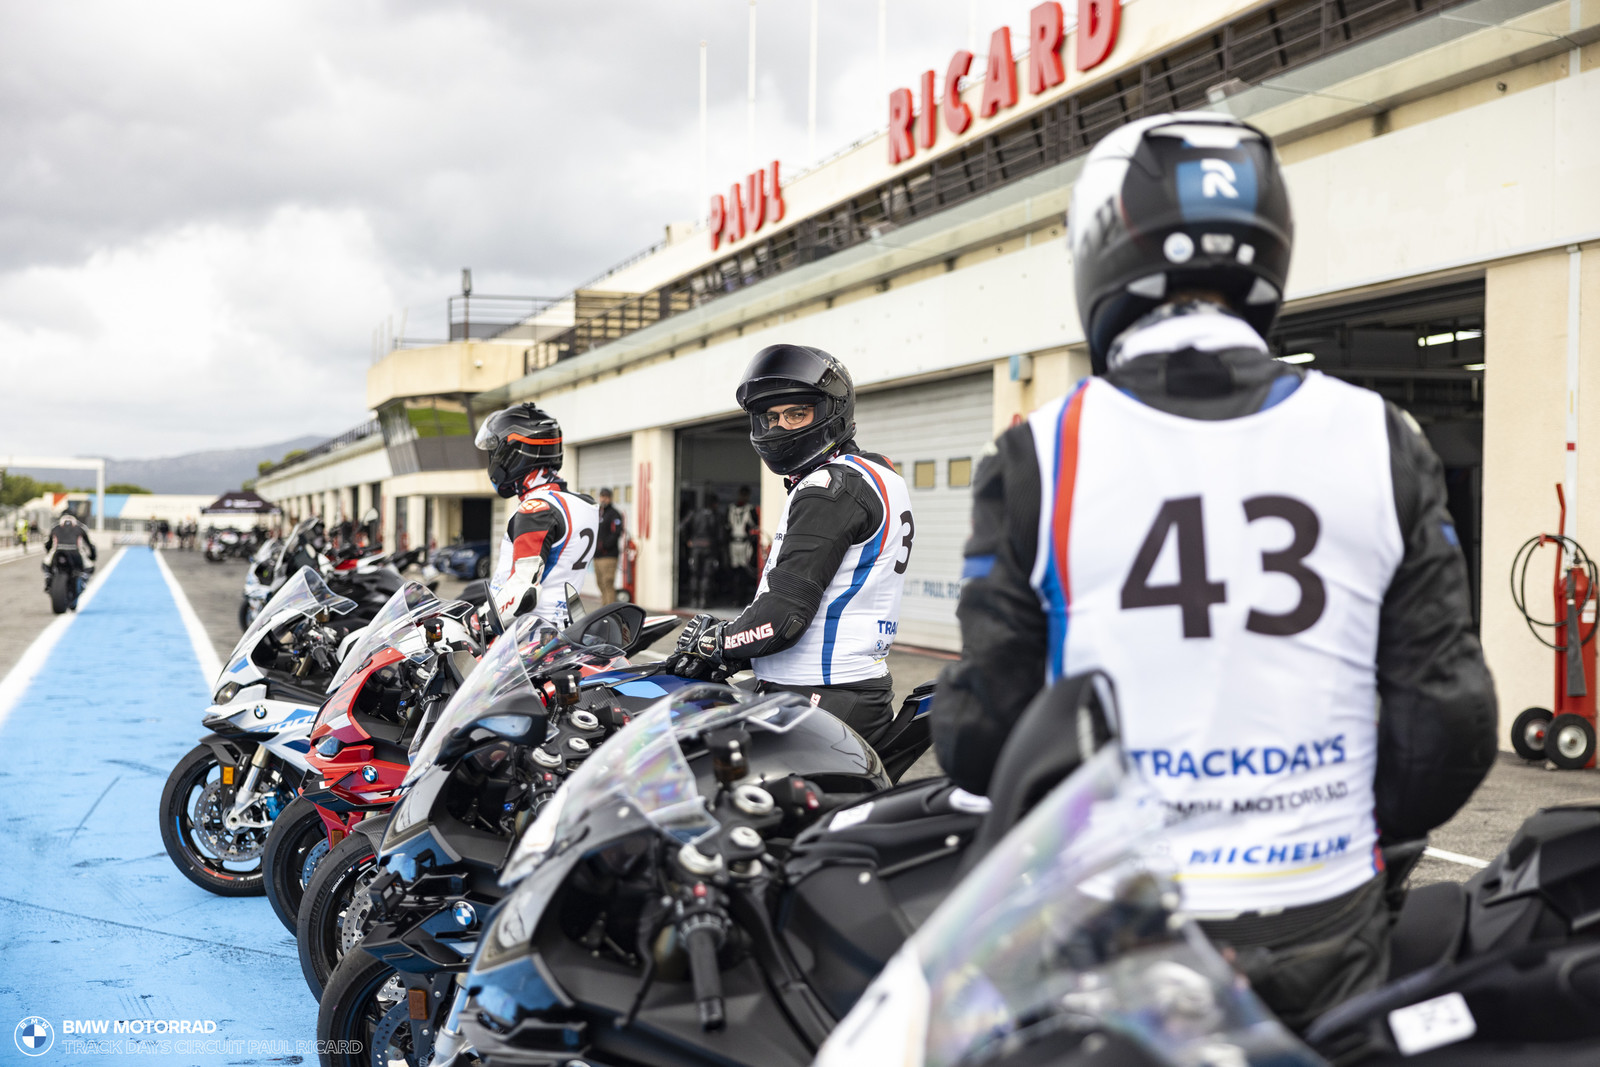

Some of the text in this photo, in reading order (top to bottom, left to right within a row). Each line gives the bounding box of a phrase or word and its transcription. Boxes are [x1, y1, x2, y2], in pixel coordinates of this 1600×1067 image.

[711, 0, 1122, 251] PAUL RICARD
[894, 510, 915, 574] 3
[1119, 493, 1328, 639] 43
[724, 622, 774, 649] BERING
[1130, 734, 1347, 778] TRACKDAYS
[1189, 833, 1352, 865] MICHELIN
